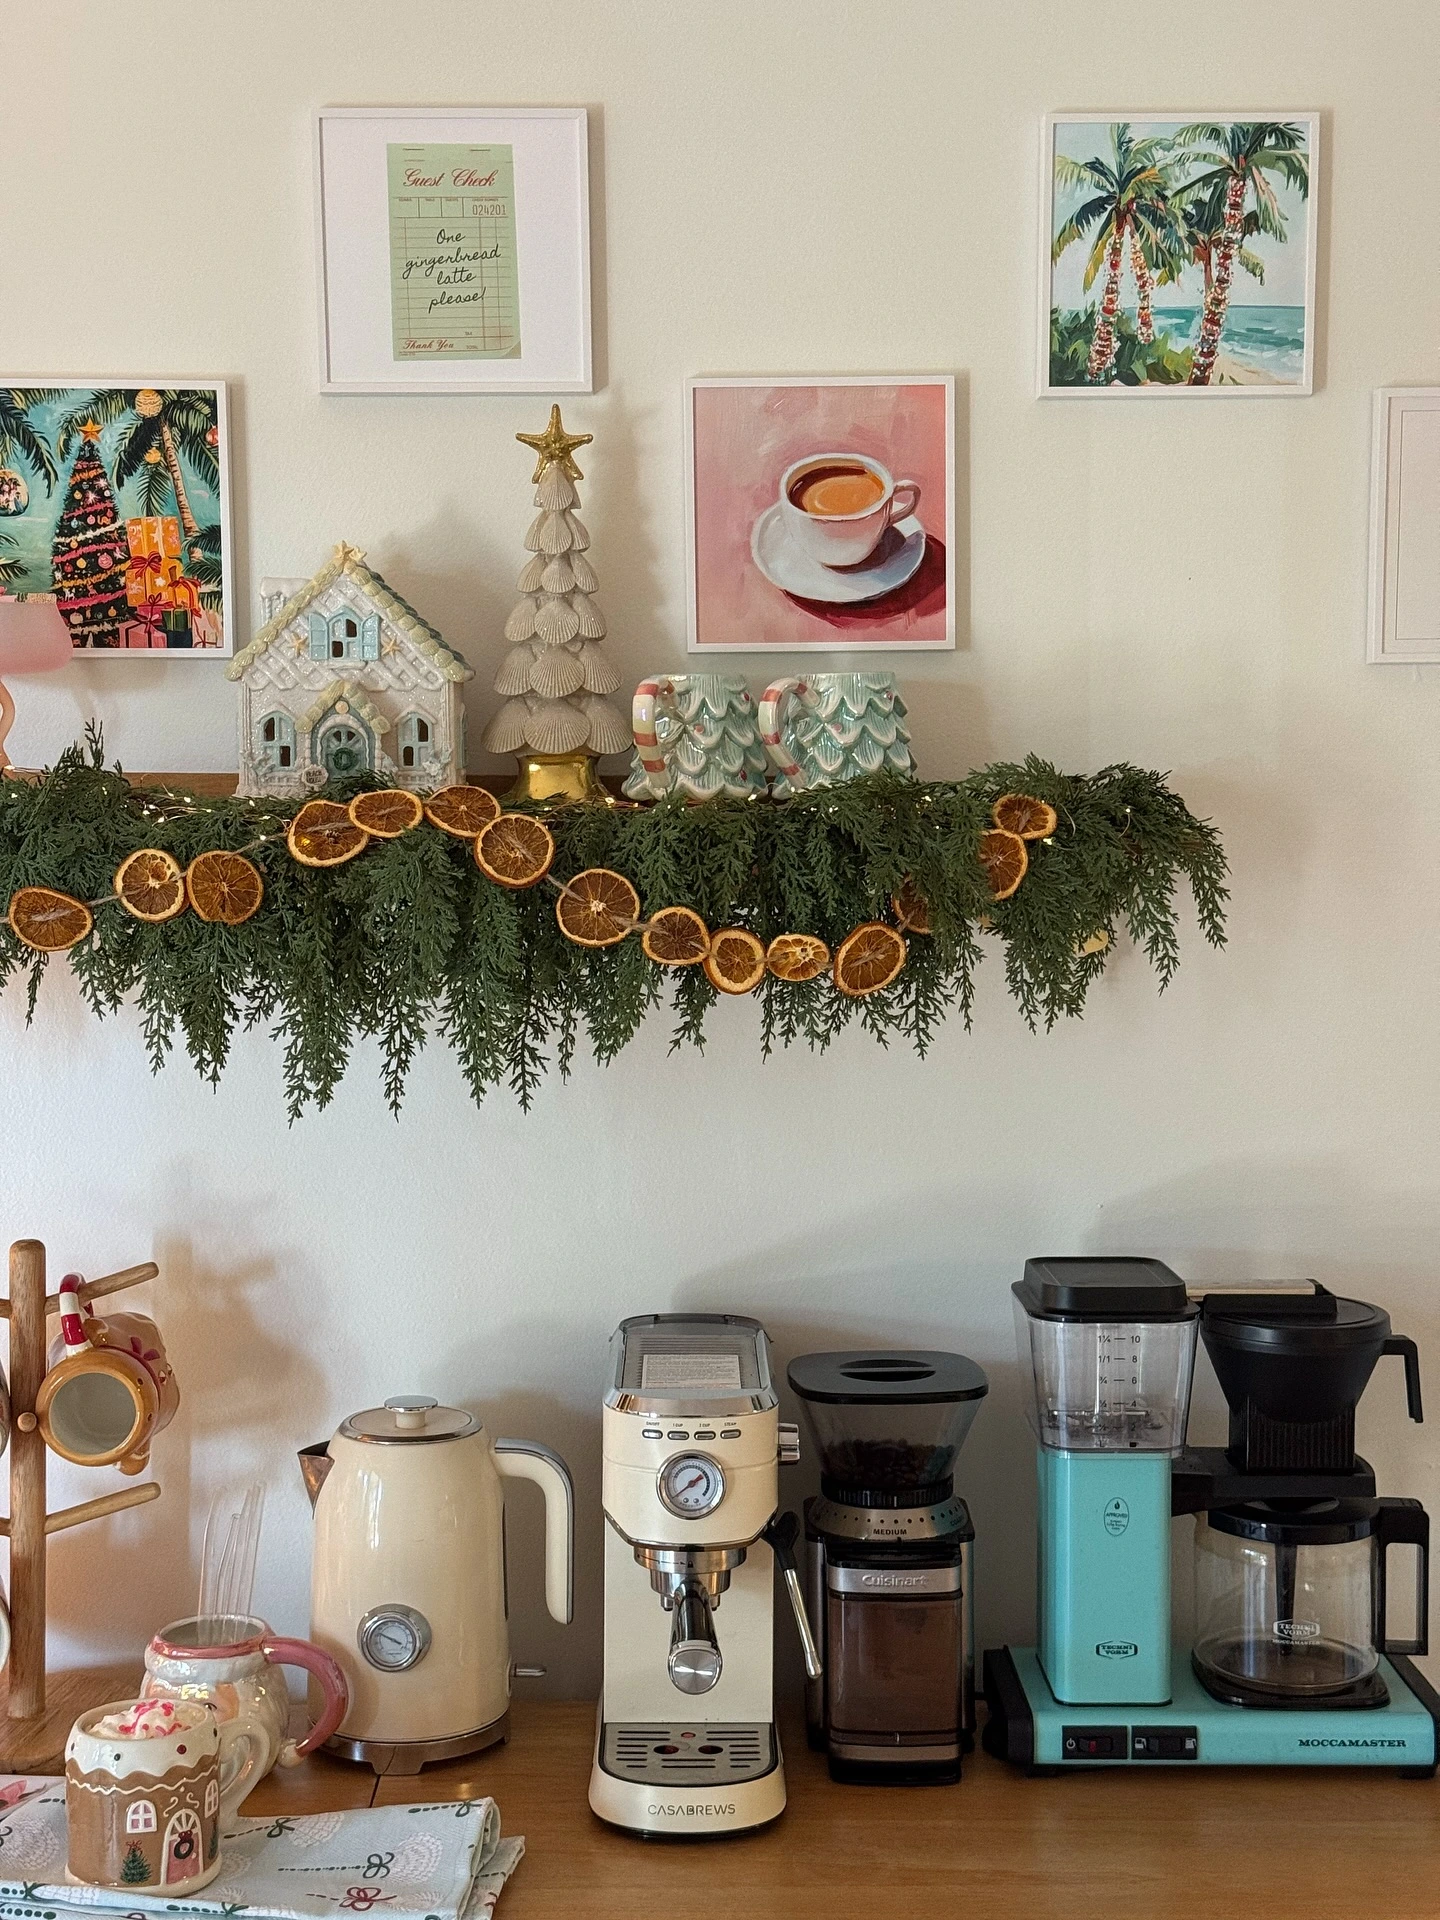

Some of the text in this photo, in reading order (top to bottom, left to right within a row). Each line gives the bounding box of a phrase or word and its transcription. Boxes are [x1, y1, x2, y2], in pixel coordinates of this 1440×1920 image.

[403, 168, 499, 187] Guest Check
[472, 204, 506, 216] 024201
[436, 228, 466, 245] One
[402, 243, 502, 280] gingerbread
[437, 266, 477, 285] latte
[428, 287, 487, 314] please!
[402, 339, 454, 351] Thank You
[1130, 1335, 1141, 1343] 10
[1098, 1354, 1138, 1363] 1/1 8
[1131, 1376, 1138, 1384] 6
[1130, 1400, 1137, 1408] 4
[873, 1528, 908, 1536] MEDIUM
[862, 1574, 927, 1587] Cuisinart
[1298, 1739, 1407, 1747] MOCCAMASTER
[647, 1803, 736, 1816] CASABREWS
